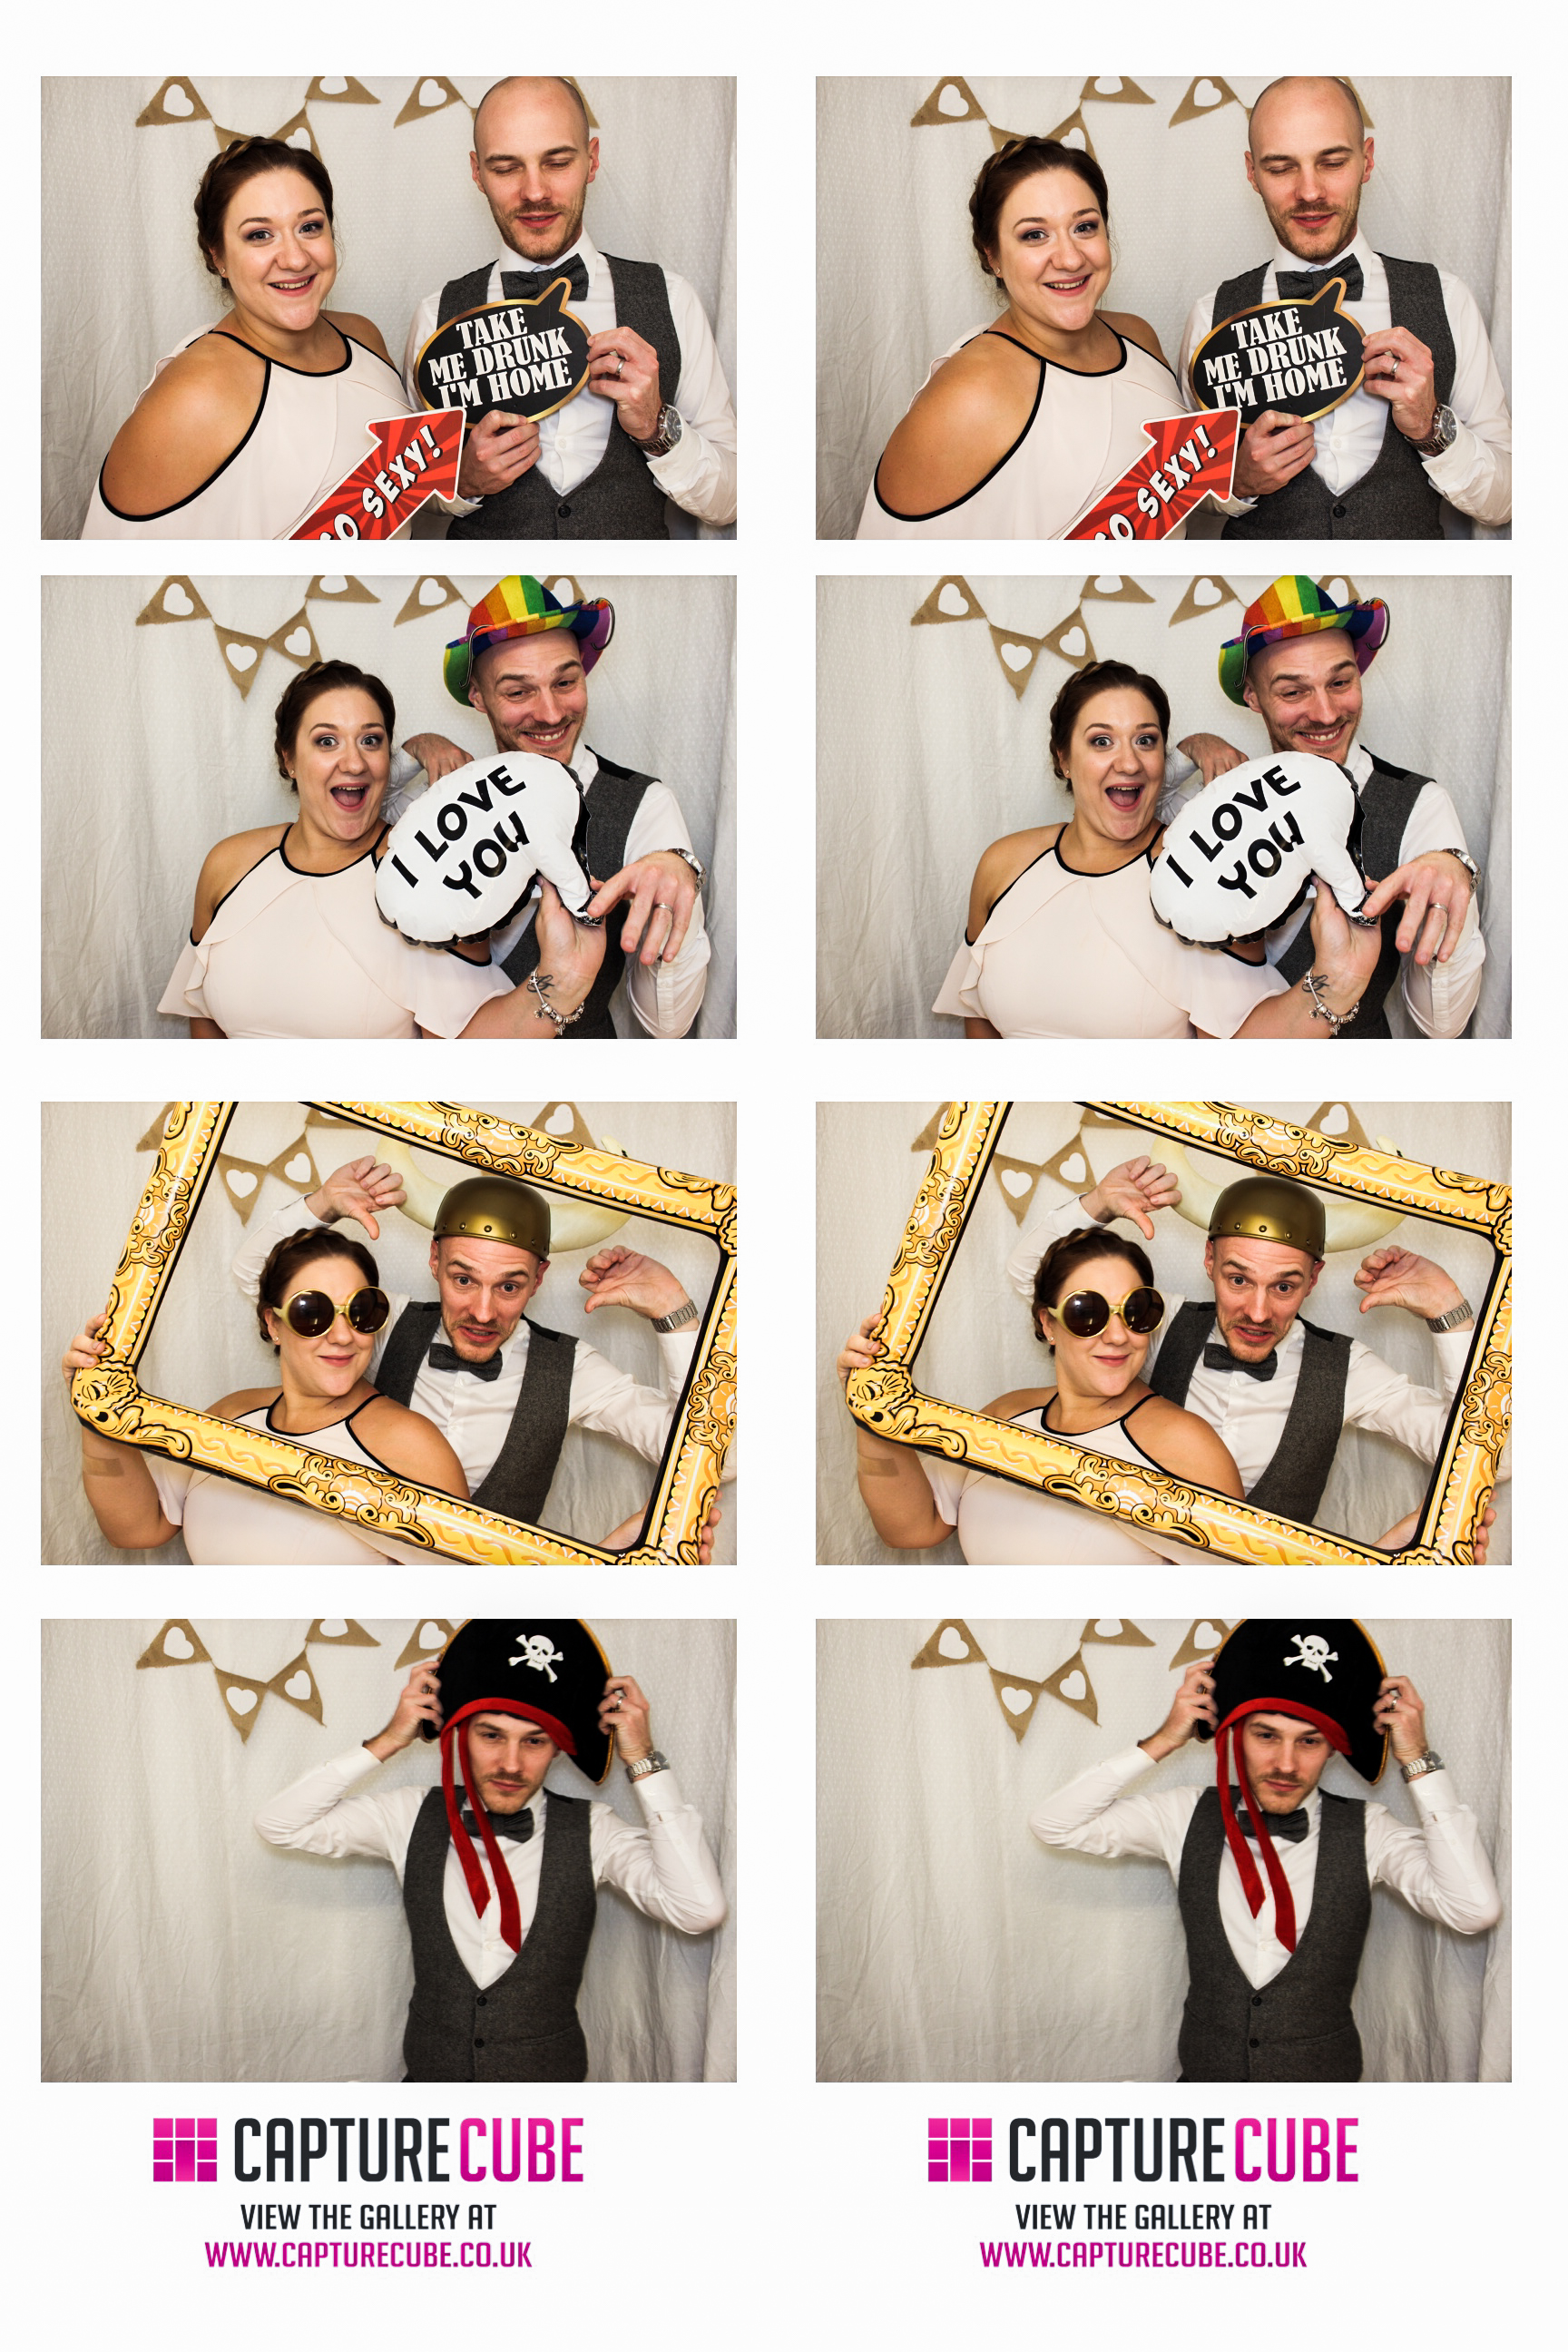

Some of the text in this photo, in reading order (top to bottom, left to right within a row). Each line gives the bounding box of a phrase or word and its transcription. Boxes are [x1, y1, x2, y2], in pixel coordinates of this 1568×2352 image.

[427, 326, 573, 387] ME DRUNK
[456, 307, 528, 349] TAKE
[1202, 326, 1348, 387] ME DRUNK
[1230, 307, 1303, 349] TAKE
[438, 358, 573, 409] I'M HOME
[1213, 358, 1348, 409] I'M HOME
[319, 424, 444, 540] O SEXY!
[1094, 424, 1219, 540] O SEXY!
[391, 764, 526, 888] I LOVE
[442, 810, 531, 900] YOU
[1166, 764, 1301, 888] I LOVE
[1217, 810, 1306, 900] YOU
